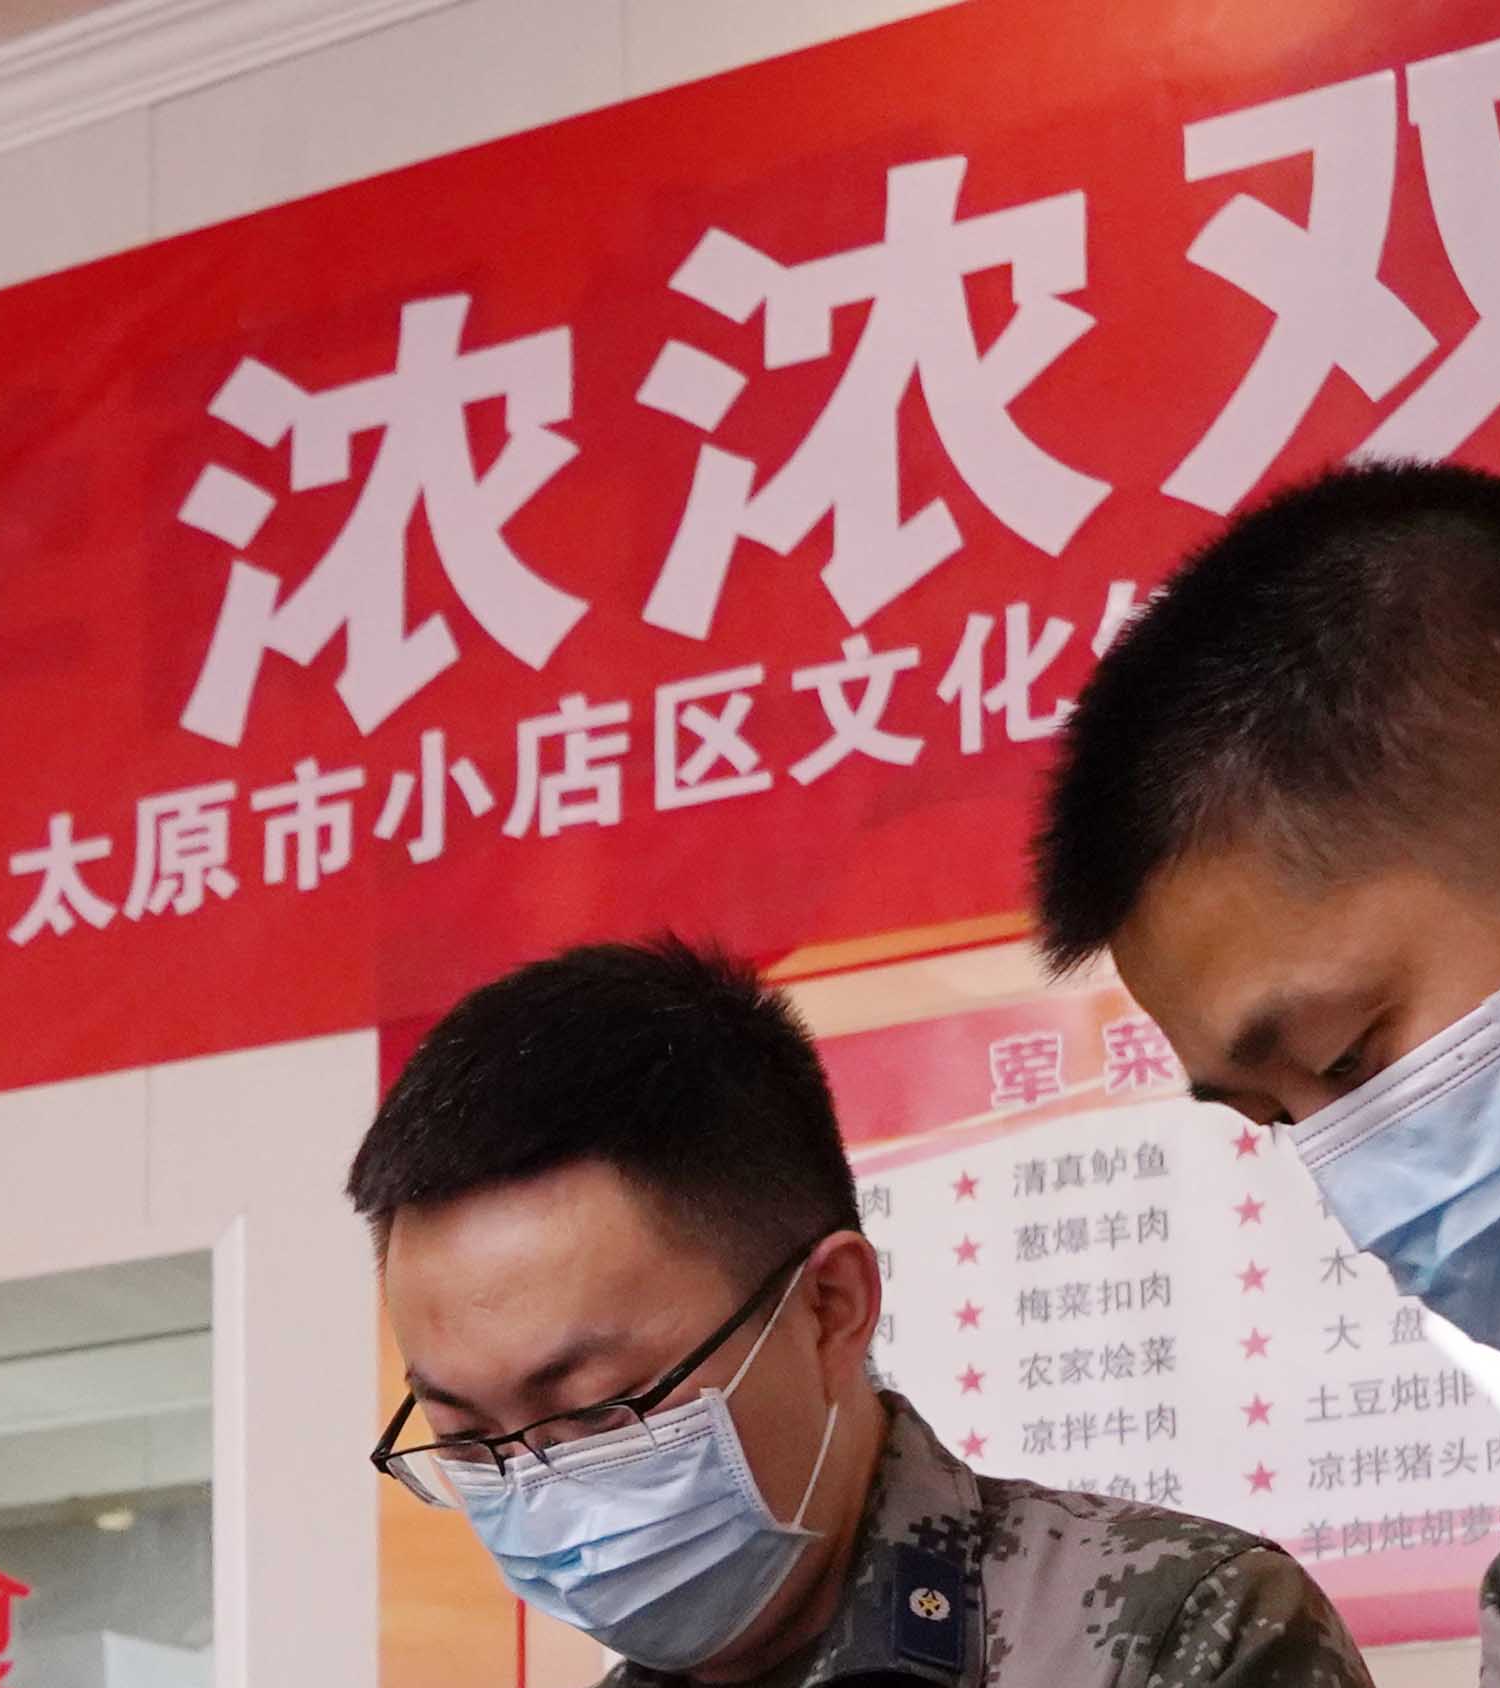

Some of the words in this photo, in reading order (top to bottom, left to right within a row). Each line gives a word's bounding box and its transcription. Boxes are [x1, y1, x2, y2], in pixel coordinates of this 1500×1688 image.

[1015, 1271, 1172, 1326] 梅菜扣肉
[1303, 1367, 1493, 1424] 土豆炖排
[1020, 1402, 1178, 1455] 凉拌牛肉
